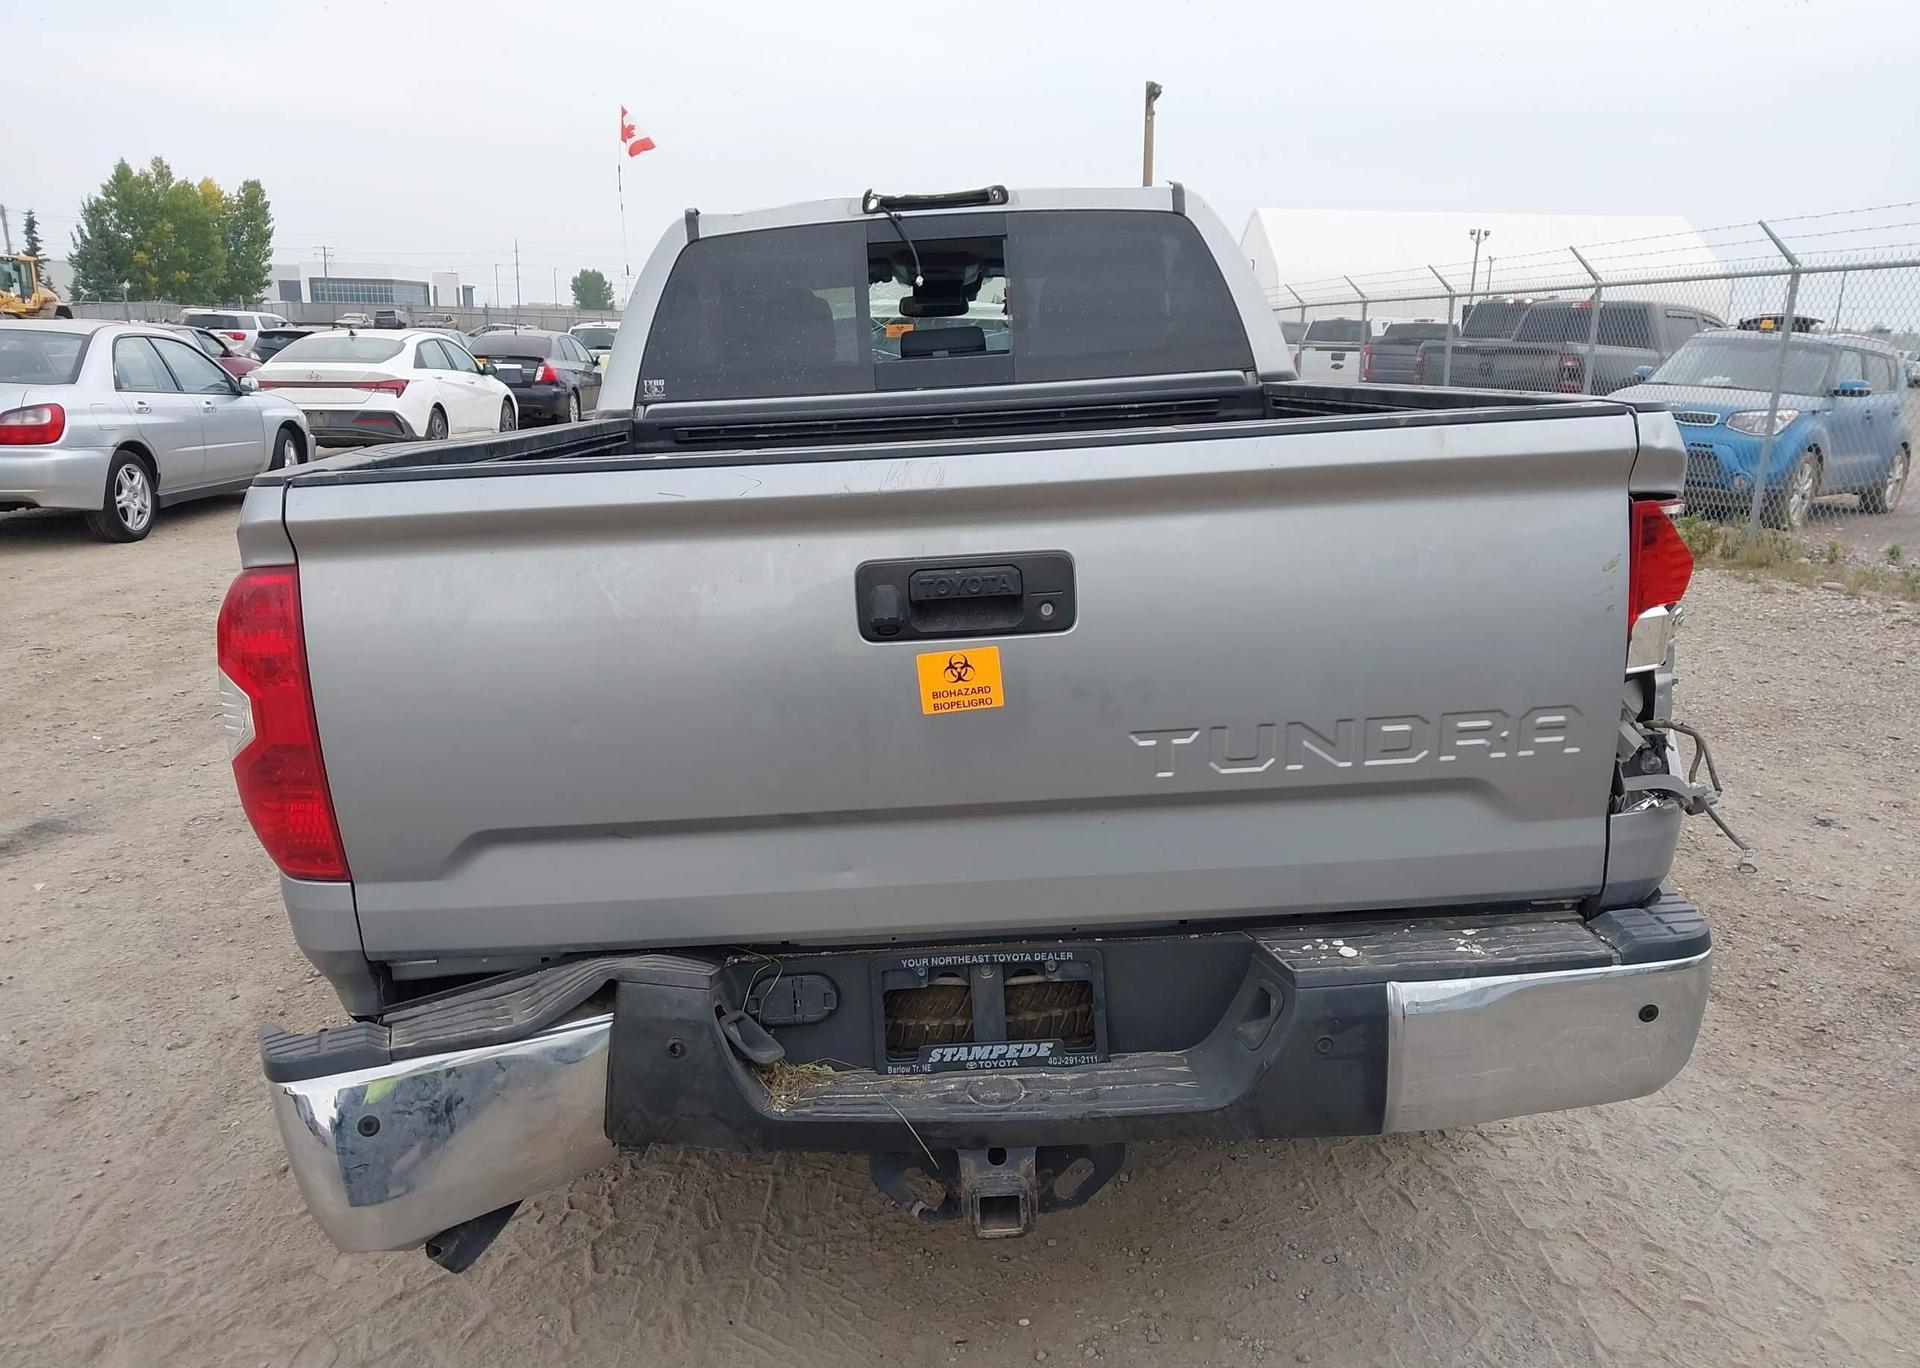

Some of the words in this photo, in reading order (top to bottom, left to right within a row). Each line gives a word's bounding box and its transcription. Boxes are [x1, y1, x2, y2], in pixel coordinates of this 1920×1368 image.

[919, 575, 1014, 598] TOYOTA
[932, 686, 991, 699] BIOHAZARD
[933, 697, 993, 711] BIOPELIGRO
[1129, 705, 1585, 778] TUNDRA
[901, 958, 929, 968] YOUR
[931, 954, 990, 966] NORTHEAST
[992, 953, 1032, 962] TOYOTA
[1034, 952, 1073, 961] DEALER
[928, 1042, 1054, 1063] STAMPEDE
[887, 1065, 911, 1074] Barlow
[912, 1064, 921, 1073] Tr.
[922, 1064, 932, 1072] NE
[979, 1059, 1019, 1069] TOYOTA
